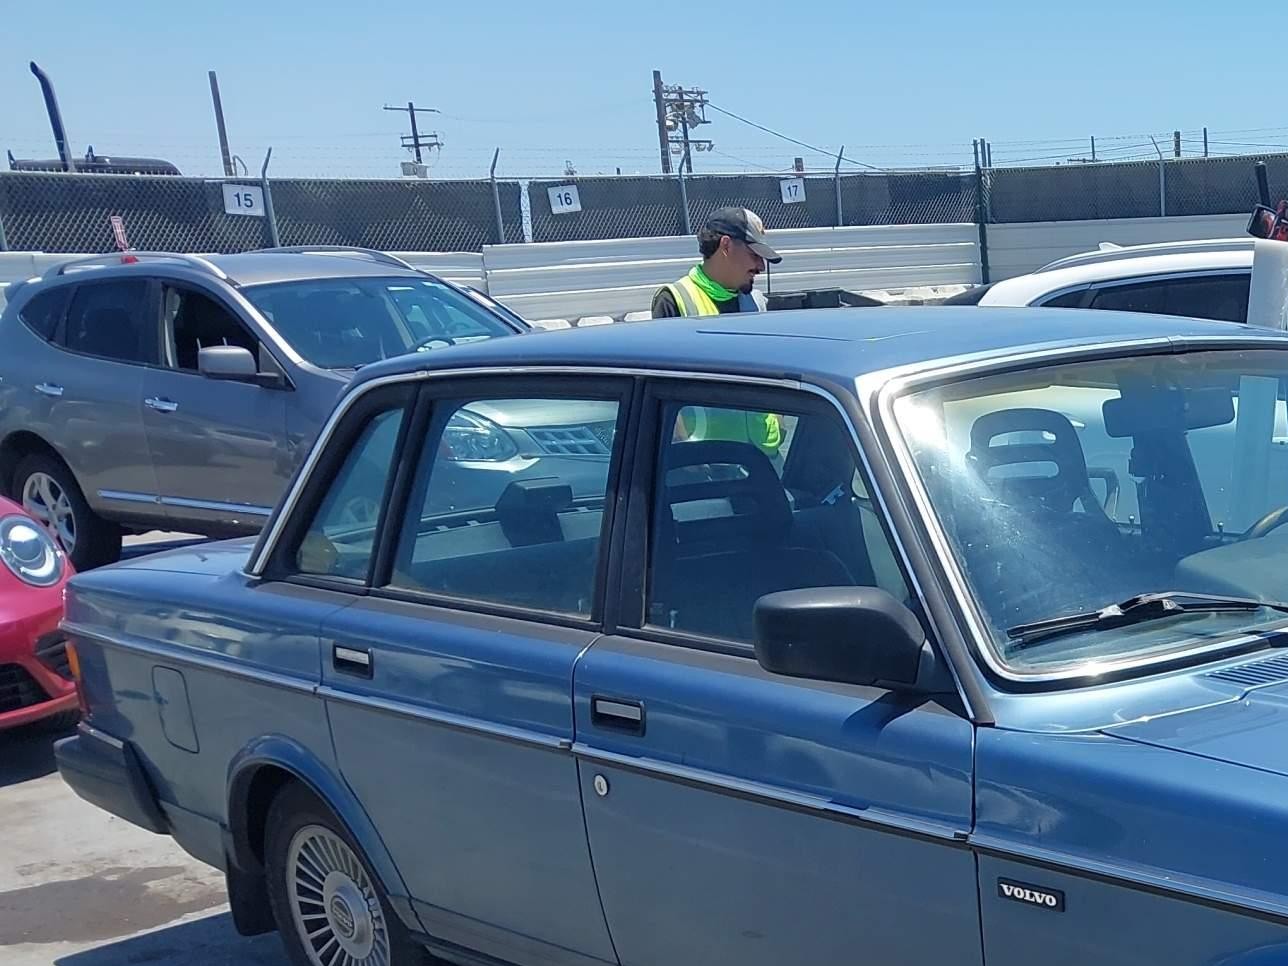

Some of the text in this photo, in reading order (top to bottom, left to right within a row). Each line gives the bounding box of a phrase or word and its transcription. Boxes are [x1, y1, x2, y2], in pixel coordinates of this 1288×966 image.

[787, 185, 798, 197] 17
[233, 192, 253, 208] 15
[557, 192, 573, 206] 16
[1000, 883, 1057, 906] VOLVO
